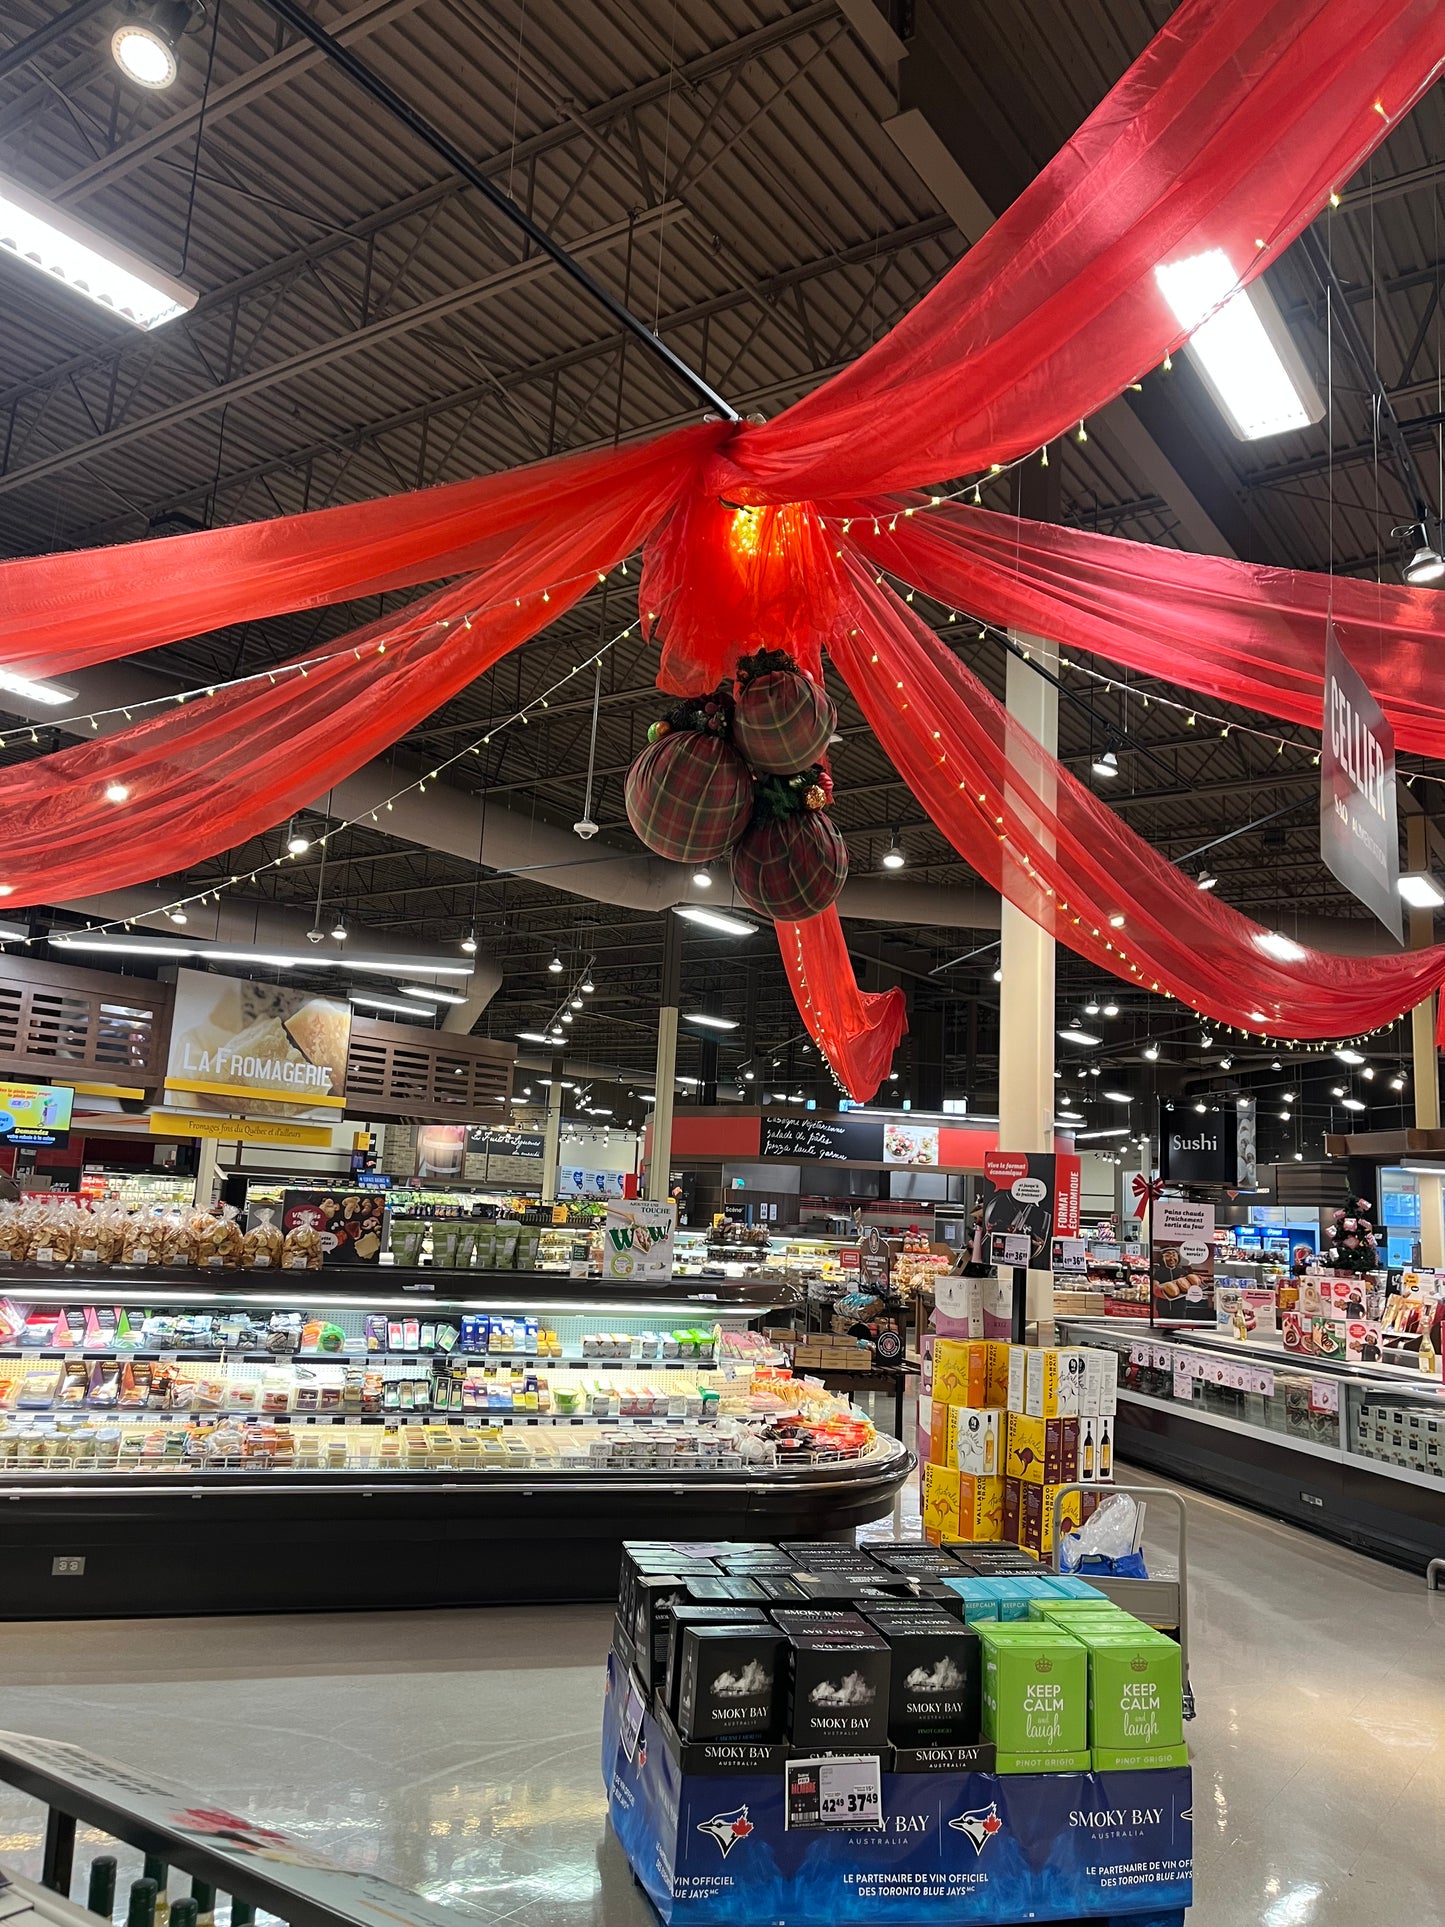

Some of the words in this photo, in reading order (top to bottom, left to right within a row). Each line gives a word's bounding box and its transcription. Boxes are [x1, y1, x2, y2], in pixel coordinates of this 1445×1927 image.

[1331, 675, 1385, 821] CELLIER
[188, 1121, 220, 1134] Fromages
[220, 1123, 233, 1138] fins
[234, 1124, 243, 1133] du
[244, 1125, 267, 1137] Québec
[268, 1128, 274, 1136] et
[274, 1127, 301, 1138] d'ailleurs
[1173, 1133, 1217, 1151] Sushi
[989, 1169, 1023, 1177] économique
[1068, 1171, 1079, 1229] ÉCONOMIQUE
[641, 1207, 671, 1215] TOUCHE
[1057, 1191, 1068, 1229] FORMAT
[785, 1608, 821, 1616] SMOKY
[1027, 1684, 1061, 1697] KEEP
[1123, 1683, 1157, 1696] KEEP
[906, 1702, 943, 1713] SMOKY
[944, 1702, 963, 1713] BAY
[1024, 1698, 1064, 1711] CALM
[1120, 1697, 1160, 1710] CALM
[711, 1708, 748, 1720] SMOKY
[750, 1707, 768, 1718] BAY
[1038, 1715, 1050, 1724] and
[1135, 1714, 1146, 1723] and
[810, 1718, 848, 1729] SMOKY
[850, 1718, 872, 1728] BAY
[1026, 1713, 1062, 1744] laugh
[1123, 1712, 1159, 1743] laugh
[704, 1746, 747, 1758] SMOKY
[749, 1746, 773, 1758] BAY
[916, 1750, 956, 1761] SMOKY
[958, 1748, 980, 1760] BAY
[1016, 1759, 1042, 1767] PINOT
[1045, 1758, 1074, 1766] GRIGIO
[1115, 1757, 1141, 1765] PINOT
[1143, 1755, 1173, 1763] GRIGIO
[895, 1815, 930, 1832] BAY
[1069, 1810, 1127, 1827] SMOKY
[1131, 1808, 1163, 1825] BAY
[1091, 1830, 1144, 1840] AUSTRALIA
[1086, 1866, 1096, 1875] LE
[1098, 1862, 1147, 1875] PARTENAIRE
[1149, 1861, 1160, 1870] DE
[1162, 1860, 1177, 1869] VIN
[673, 1877, 689, 1886] VIN
[692, 1876, 735, 1886] OFFICIEL
[843, 1874, 853, 1883] LE
[856, 1873, 912, 1883] PARTENAIRE
[915, 1873, 927, 1883] DE
[929, 1873, 946, 1882] VIN
[948, 1872, 989, 1882] OFFICIEL
[1101, 1878, 1116, 1887] DES
[1119, 1873, 1154, 1885] TORONTO
[1156, 1871, 1174, 1881] BLUE
[858, 1886, 876, 1896] DES
[878, 1886, 920, 1896] TORONTO
[922, 1886, 943, 1896] BLUE
